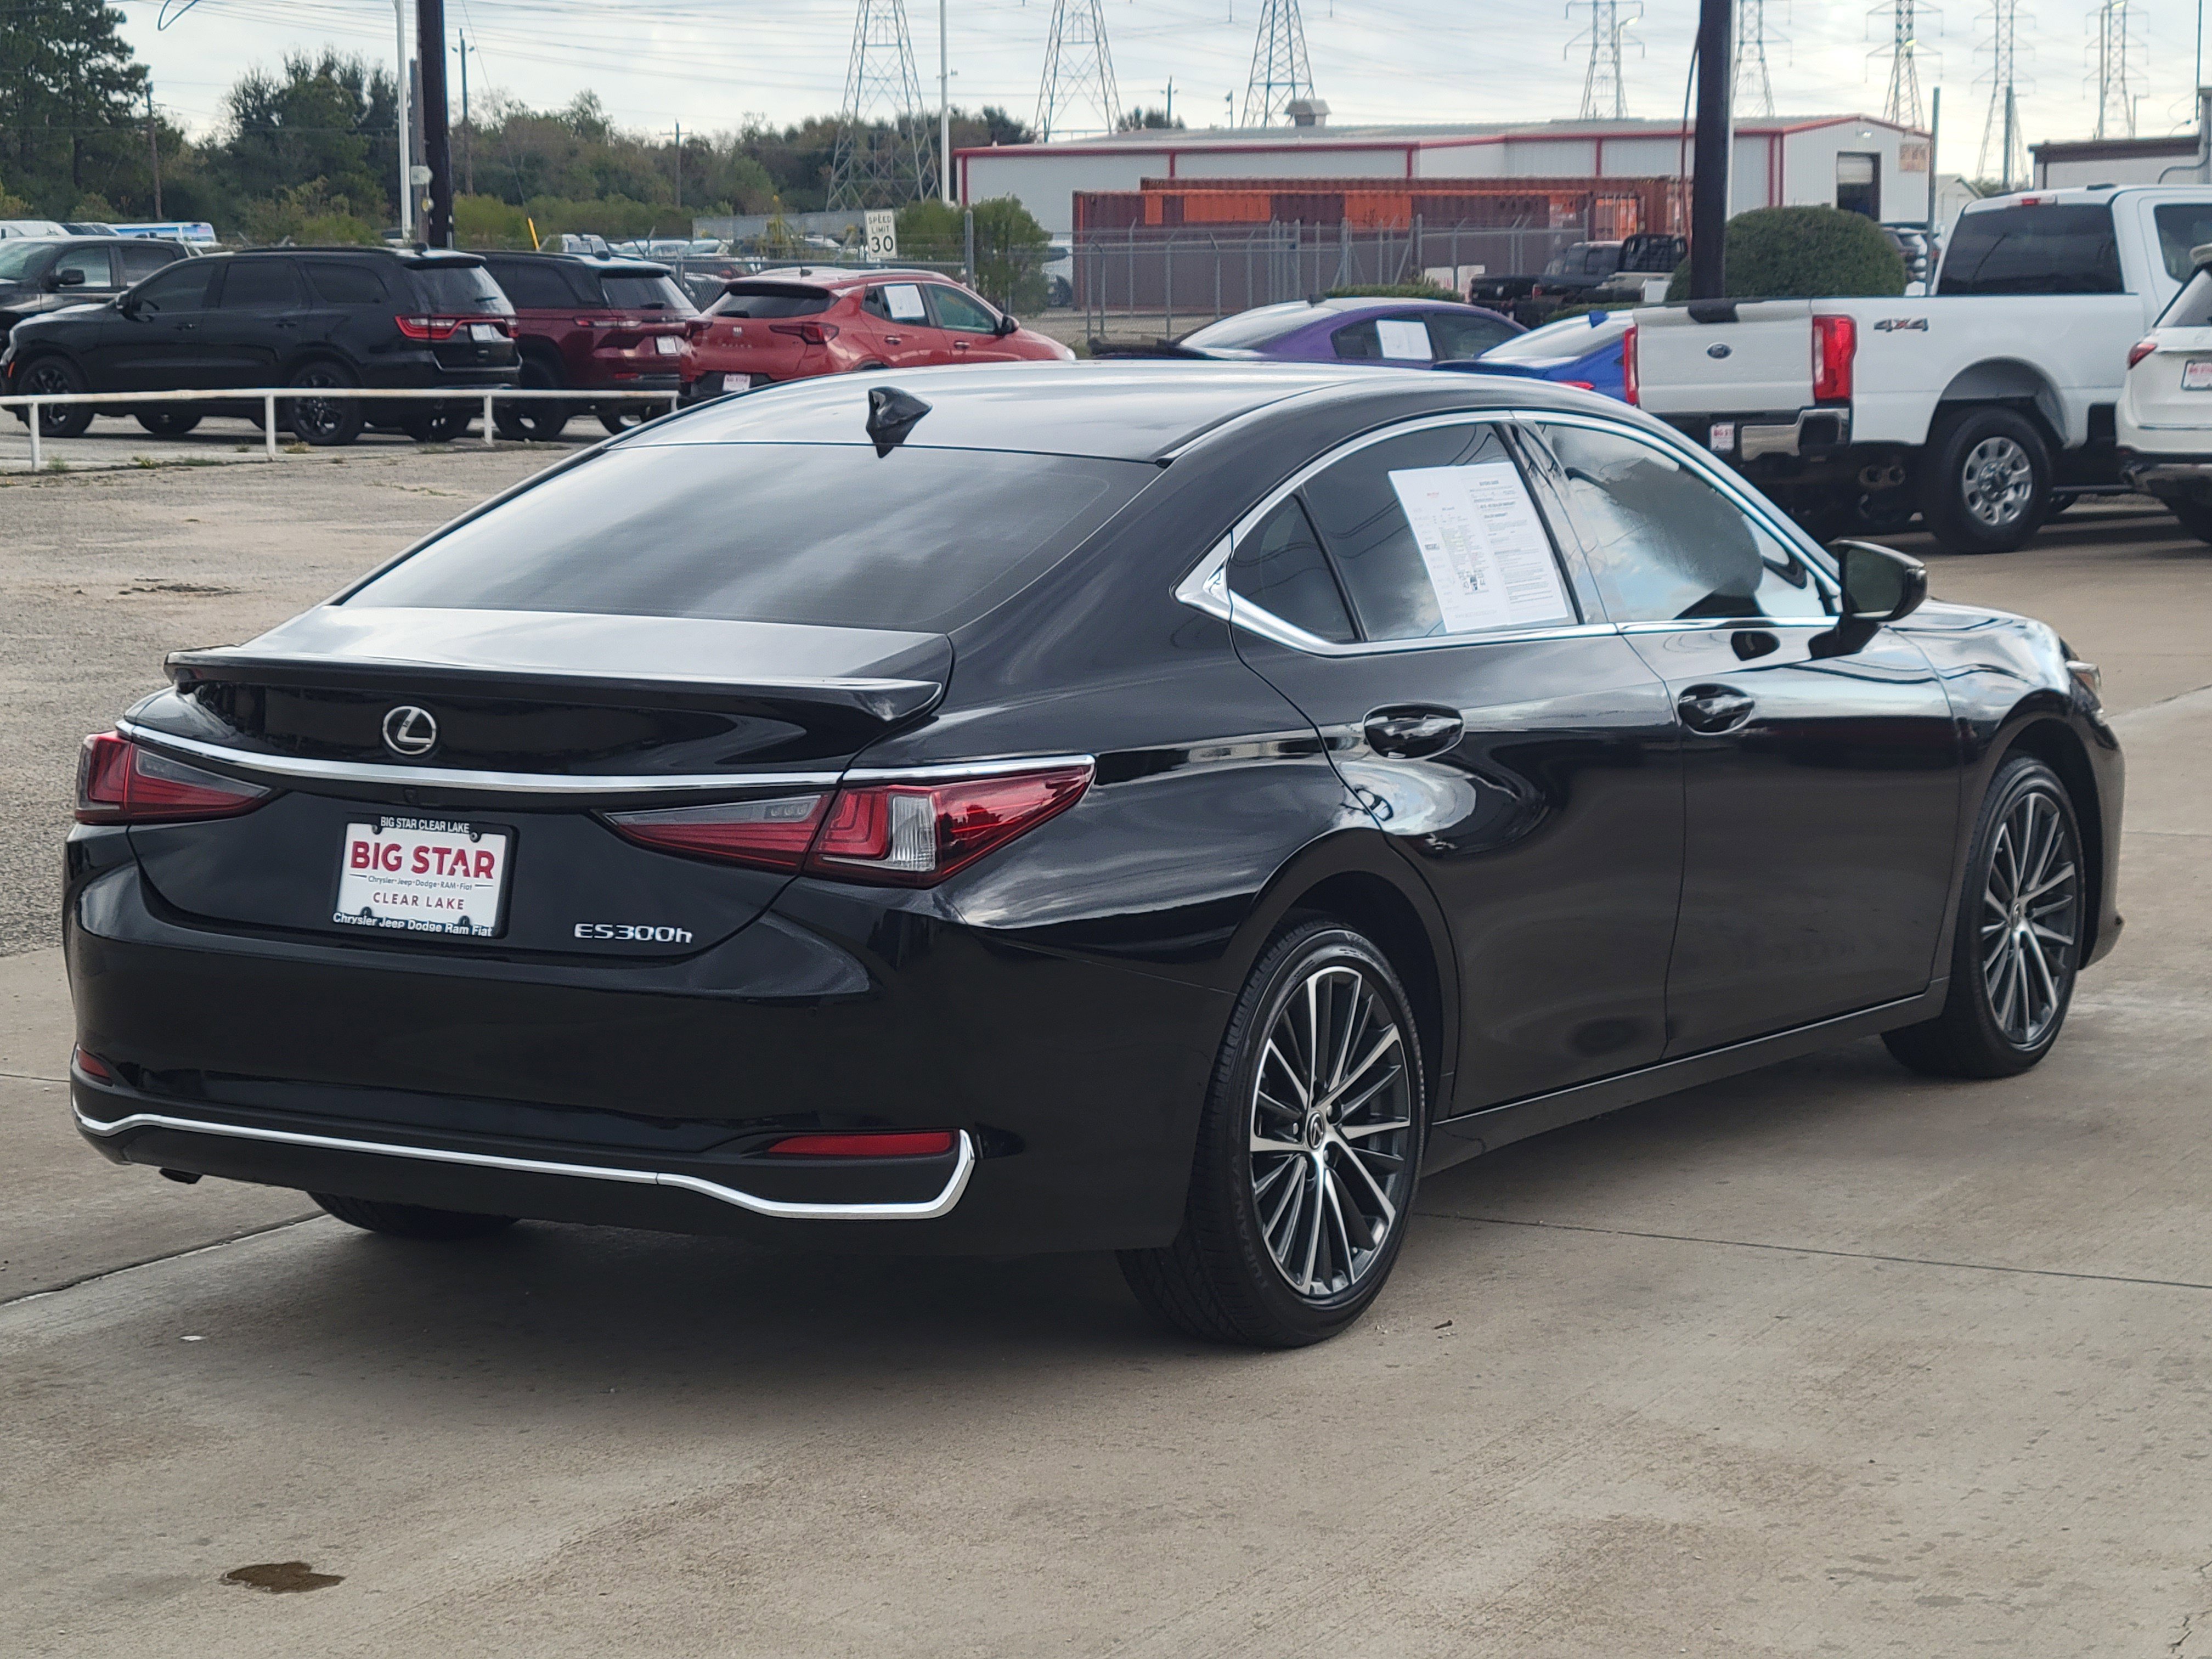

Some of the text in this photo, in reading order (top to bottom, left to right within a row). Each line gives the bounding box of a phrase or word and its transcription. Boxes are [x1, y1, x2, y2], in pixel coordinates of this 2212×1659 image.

[868, 215, 892, 224] SPEED
[871, 225, 889, 234] LIMIT
[871, 235, 894, 253] 30
[381, 816, 470, 833] BIG STAR CLEAR LAKE
[350, 841, 495, 879] BIG STAR
[460, 882, 472, 890] Fiat
[373, 891, 465, 910] CLEAR LAKE
[332, 912, 493, 937] Chrysler Jeep Dodge Ram Fiat
[574, 923, 692, 944] ES300h
